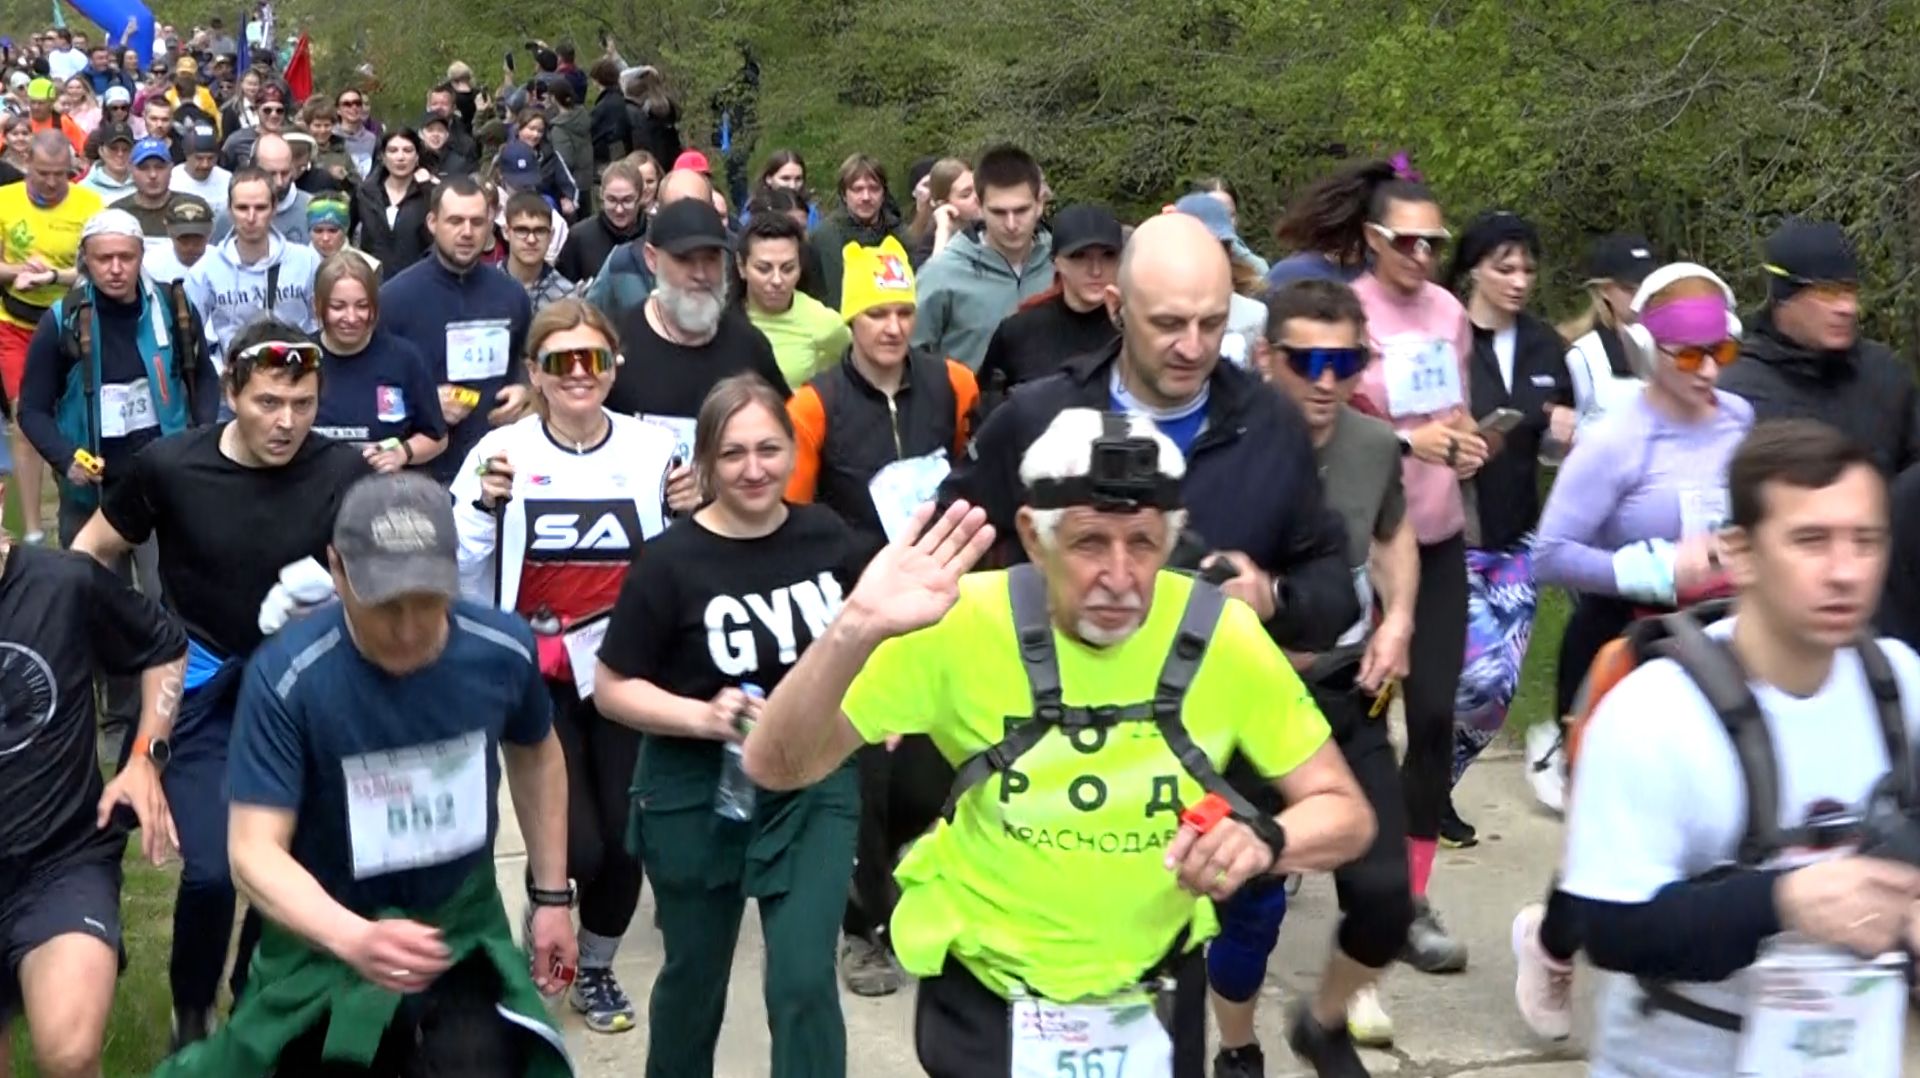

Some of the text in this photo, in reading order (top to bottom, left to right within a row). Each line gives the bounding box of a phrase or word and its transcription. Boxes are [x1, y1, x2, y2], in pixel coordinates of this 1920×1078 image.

[464, 347, 494, 362] 411
[120, 397, 147, 418] 473
[530, 511, 631, 549] SA
[1057, 1045, 1128, 1078] 567
